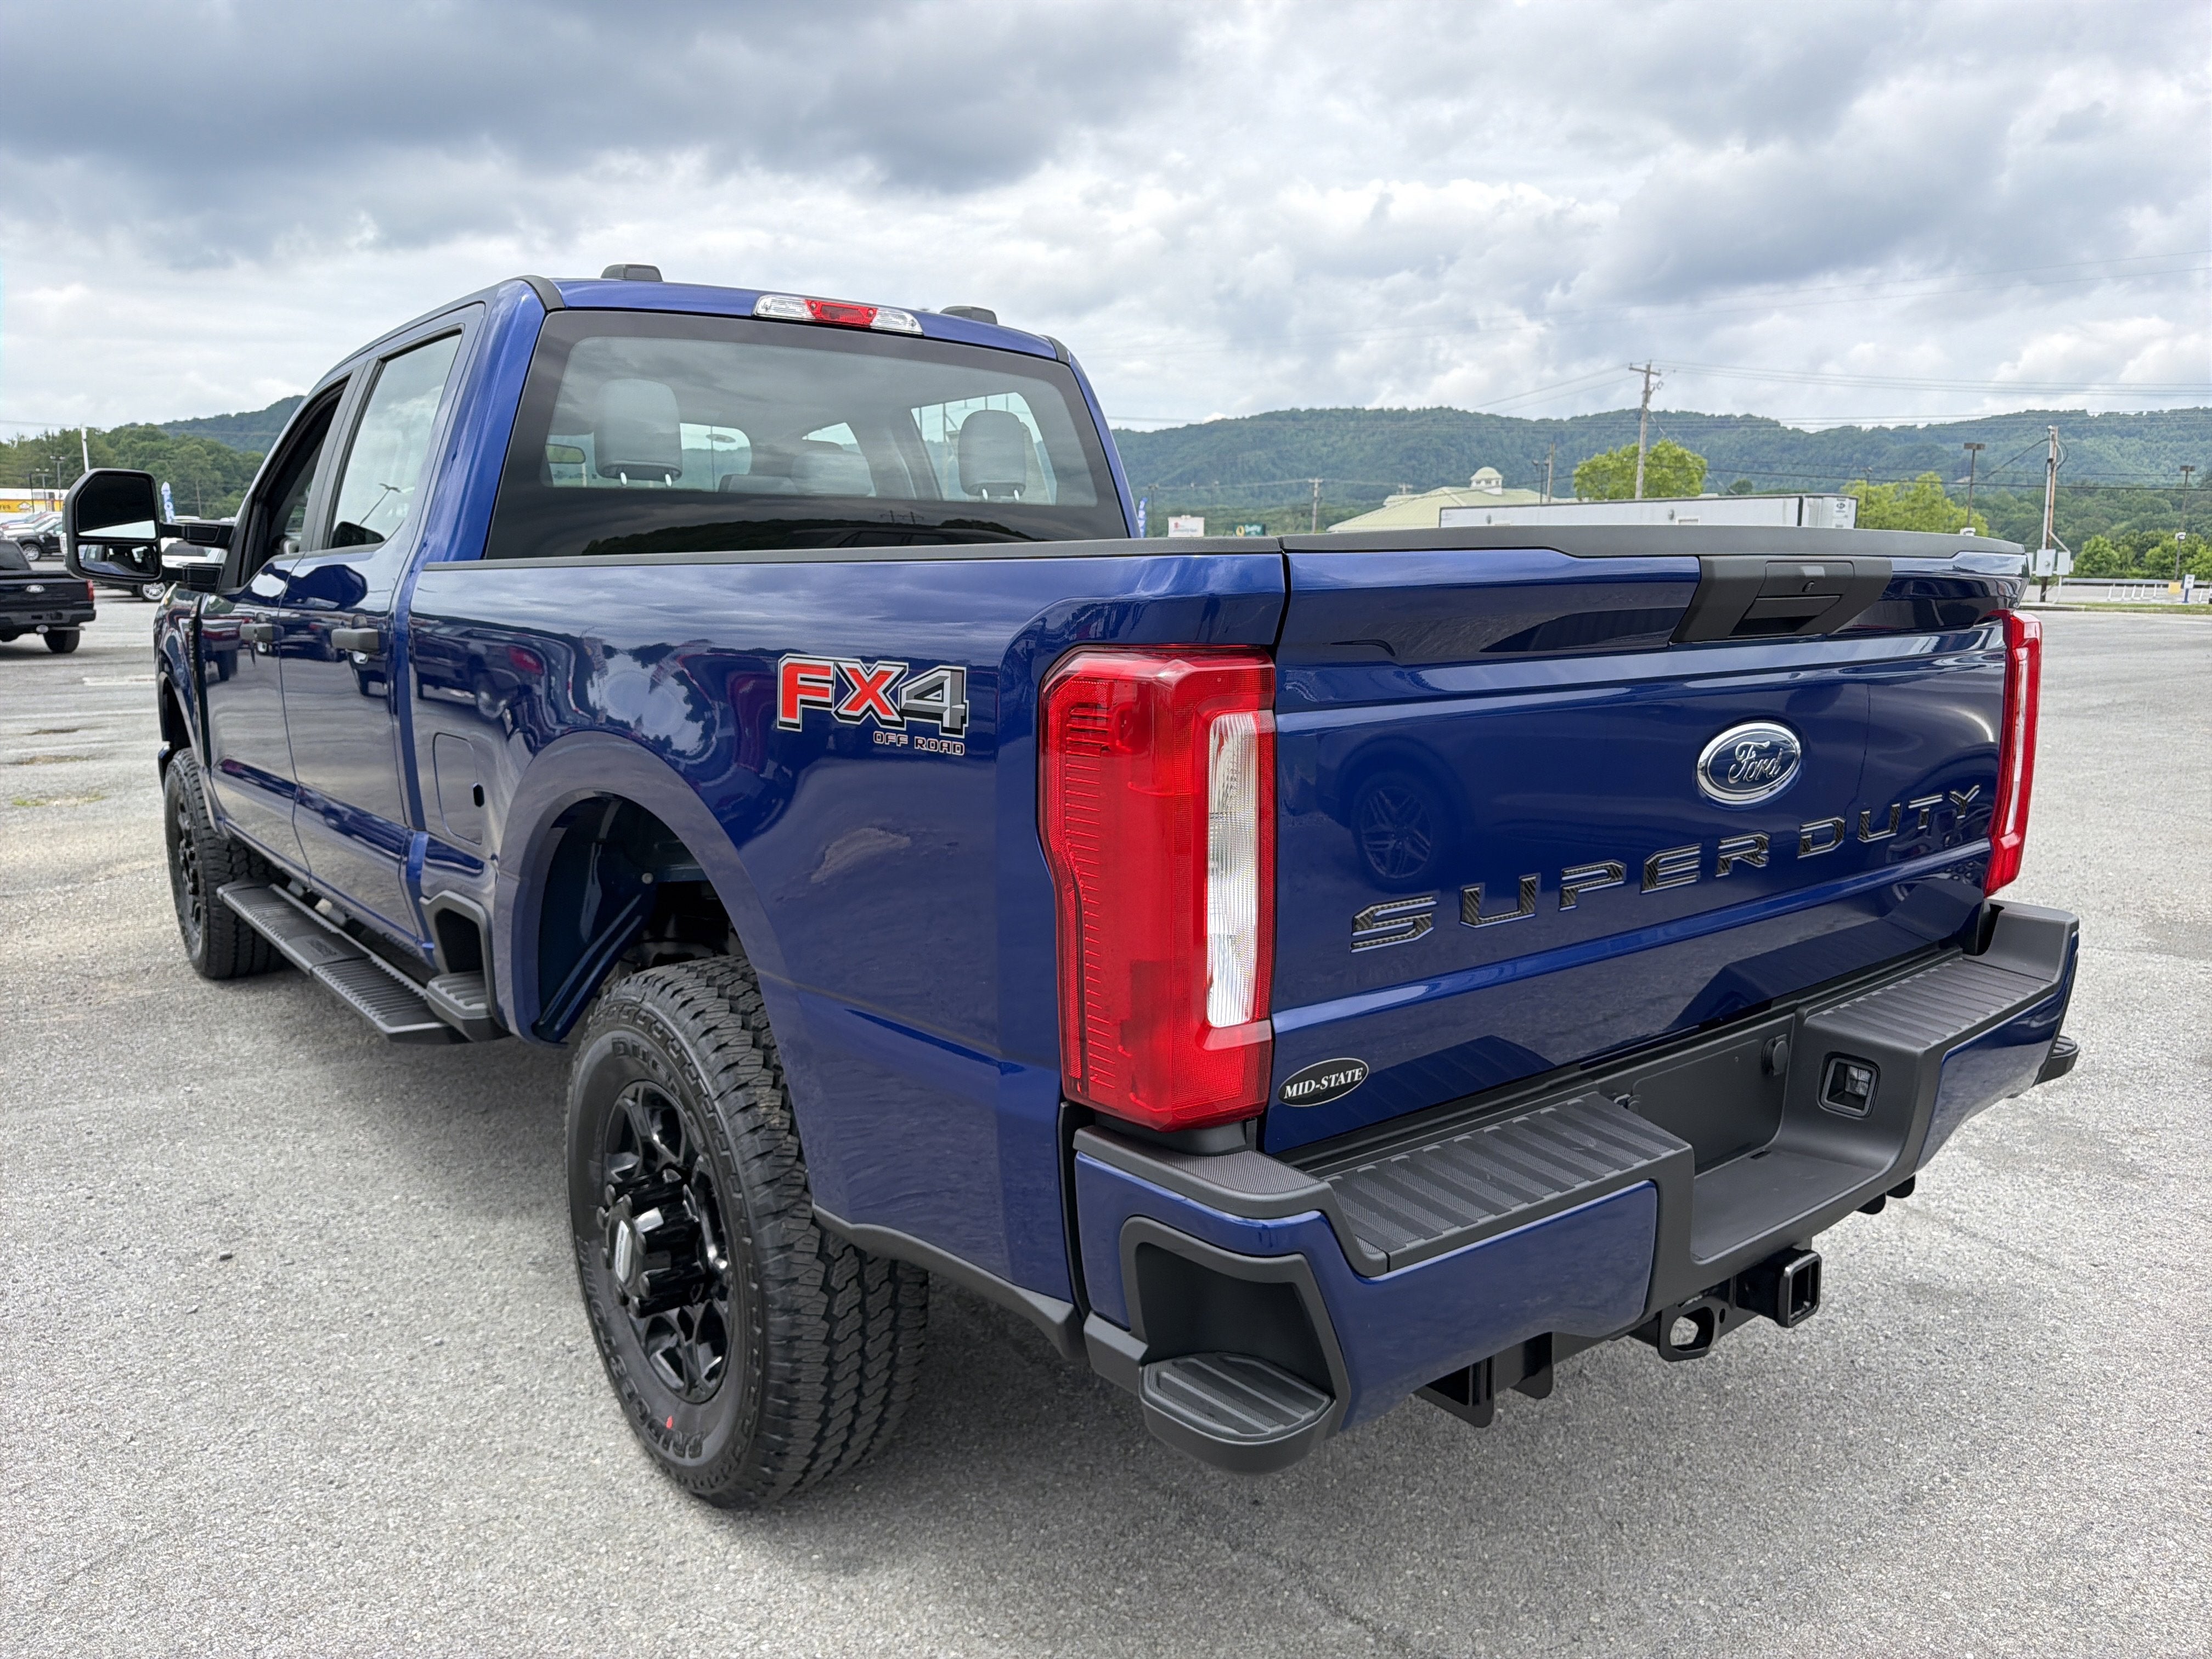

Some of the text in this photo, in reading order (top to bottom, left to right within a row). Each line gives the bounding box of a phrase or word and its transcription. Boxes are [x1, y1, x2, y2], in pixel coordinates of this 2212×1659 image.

[777, 653, 969, 738] FX4
[873, 731, 965, 756] OFF ROAD
[1728, 741, 1783, 785] Ford
[1351, 785, 1980, 953] SUPER DUTY
[1284, 1067, 1363, 1099] MID-STATE
